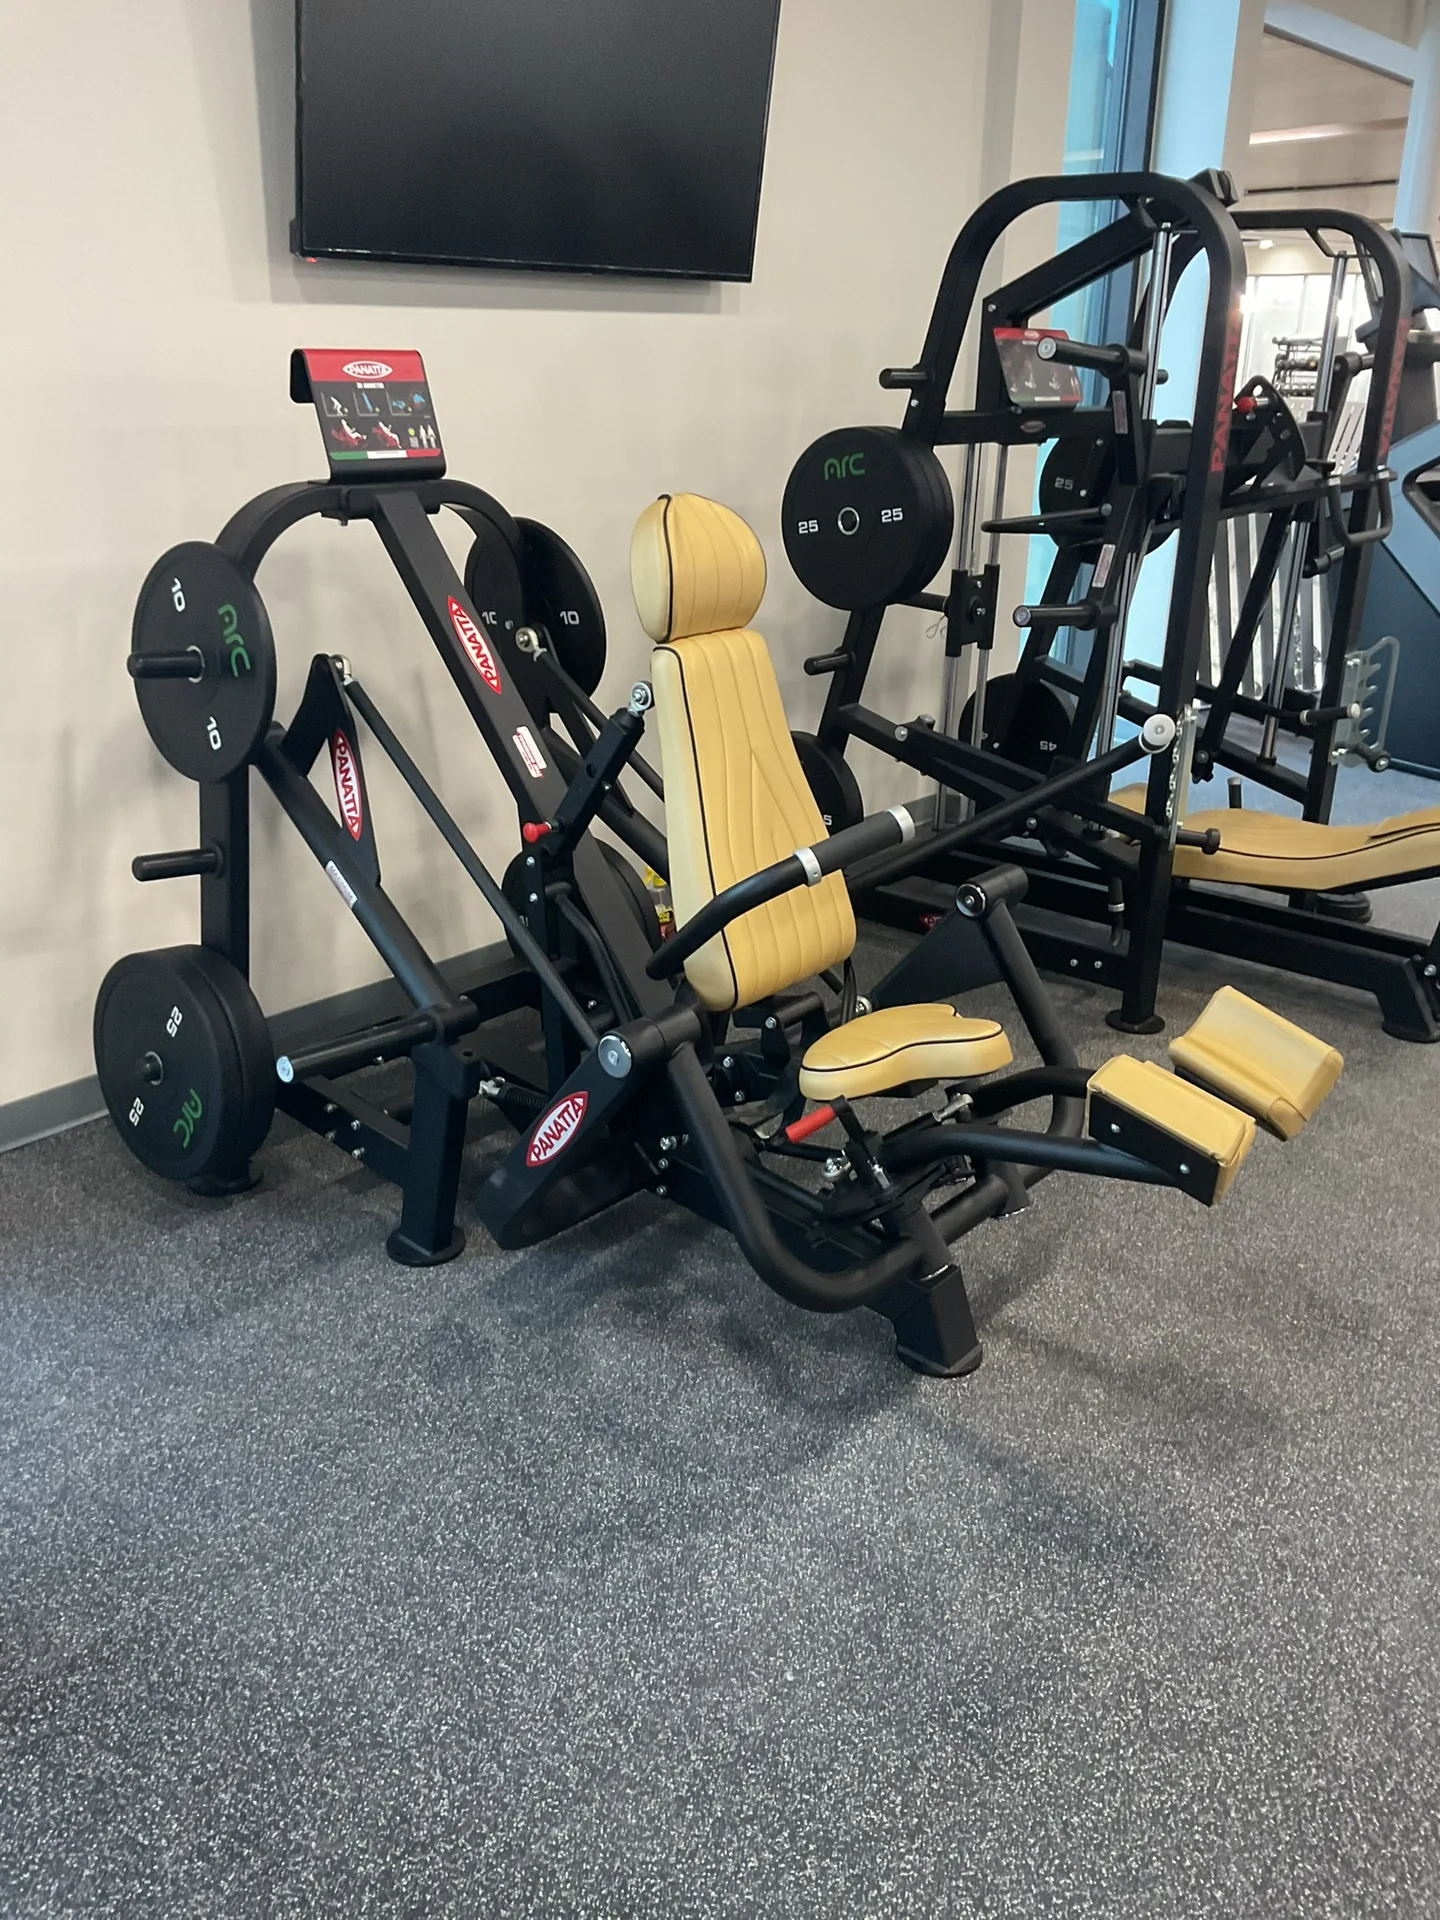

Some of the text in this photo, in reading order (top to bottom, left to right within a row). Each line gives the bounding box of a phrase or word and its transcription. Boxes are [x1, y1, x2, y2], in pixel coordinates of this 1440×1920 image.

[349, 363, 387, 376] PANATTA
[1055, 477, 1073, 491] 25
[881, 507, 903, 523] 25
[798, 520, 819, 534] 25
[171, 577, 186, 613] 10
[560, 610, 580, 625] 10
[453, 606, 496, 683] PANATTA
[206, 716, 222, 750] 10
[1040, 740, 1057, 751] 45
[336, 742, 360, 829] PANATTA
[823, 814, 832, 826] 5
[166, 1006, 183, 1038] 25
[128, 1097, 144, 1127] 25
[531, 1098, 584, 1161] PANATTA
